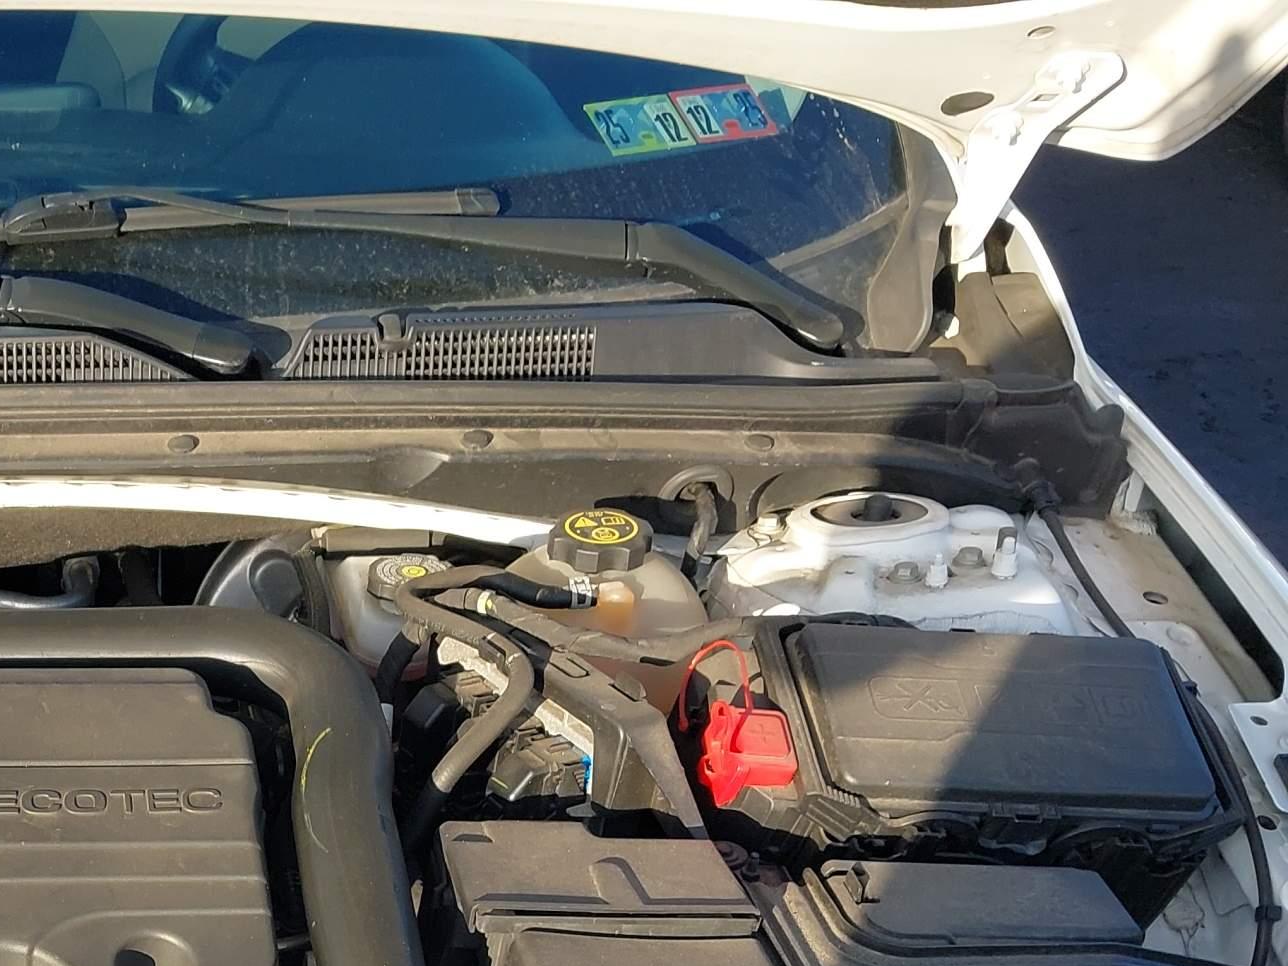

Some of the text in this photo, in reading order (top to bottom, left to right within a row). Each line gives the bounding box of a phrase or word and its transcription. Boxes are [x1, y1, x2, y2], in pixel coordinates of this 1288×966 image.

[595, 108, 689, 145] 25 12
[686, 91, 768, 135] 12 25
